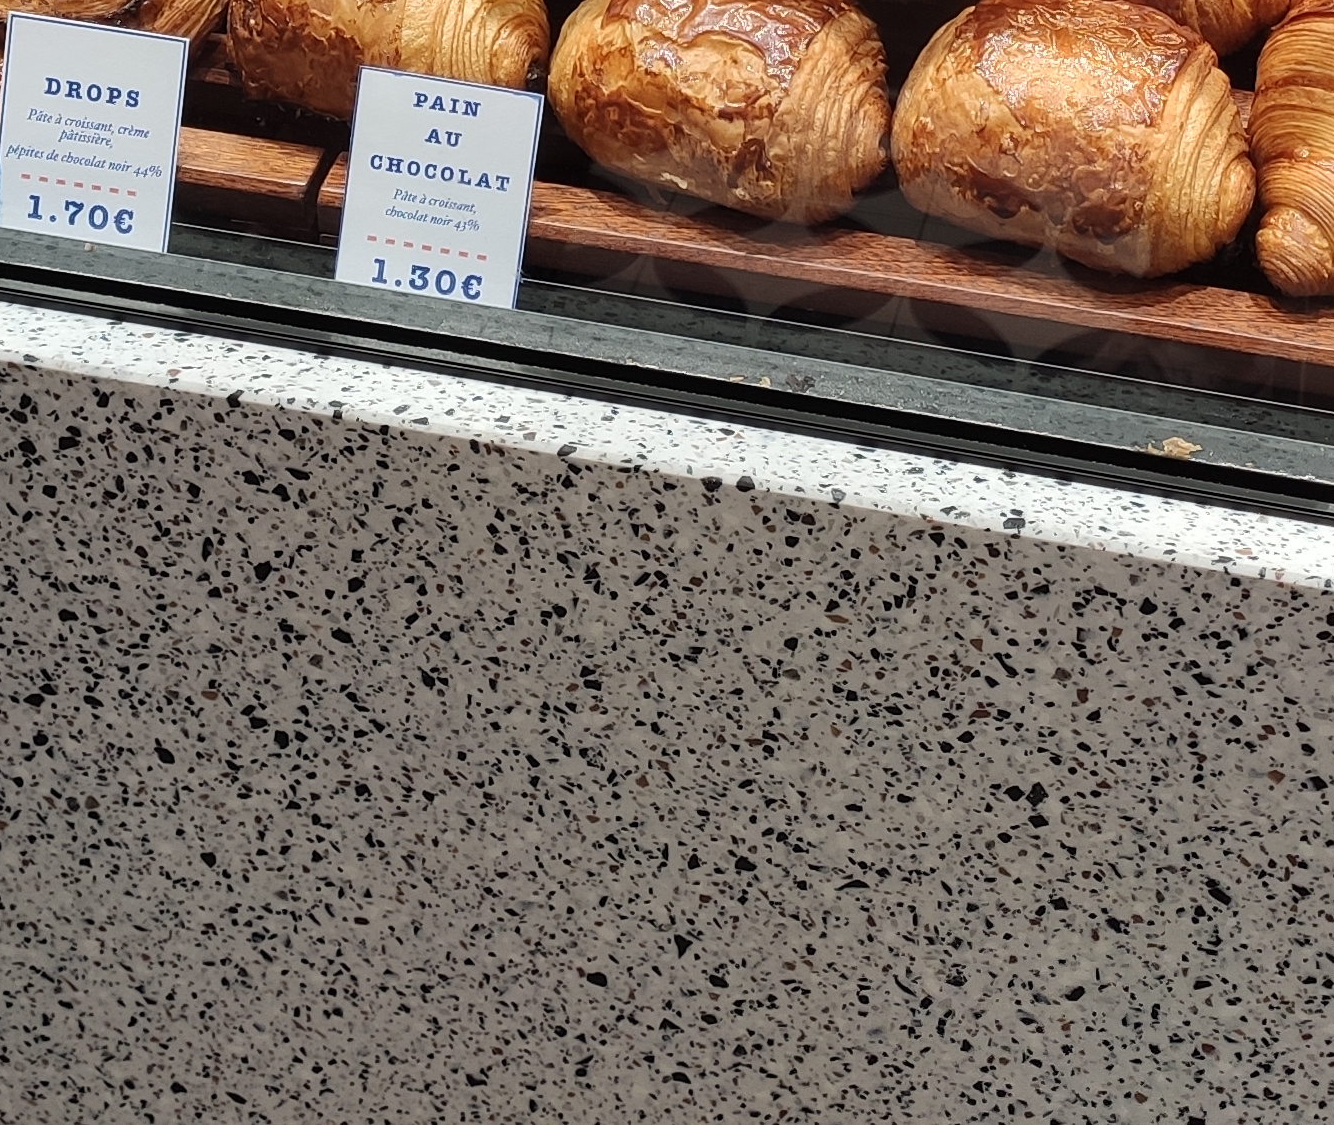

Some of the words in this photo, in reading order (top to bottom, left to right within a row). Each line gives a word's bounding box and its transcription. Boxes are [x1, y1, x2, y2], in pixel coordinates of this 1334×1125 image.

[44, 77, 140, 108] DROPS
[413, 92, 481, 117] PAIN
[27, 108, 52, 123] Pâte
[55, 114, 63, 125] à
[65, 117, 115, 134] croissant,
[118, 125, 150, 138] crème
[424, 129, 462, 147] AU
[58, 129, 113, 149] pâtissière,
[5, 144, 45, 159] pépites
[46, 149, 59, 161] de
[61, 152, 106, 169] chocolat
[108, 161, 132, 172] noir
[133, 165, 162, 178] 44%
[370, 154, 510, 191] CHOCOLAT
[27, 195, 134, 235] 1.70€
[392, 188, 417, 203] Pâte
[419, 194, 427, 204] à
[428, 198, 477, 215] croissant,
[385, 206, 428, 222] chocolat
[430, 215, 453, 226] noir
[454, 219, 480, 231] 43%
[371, 258, 483, 301] 1.30€
